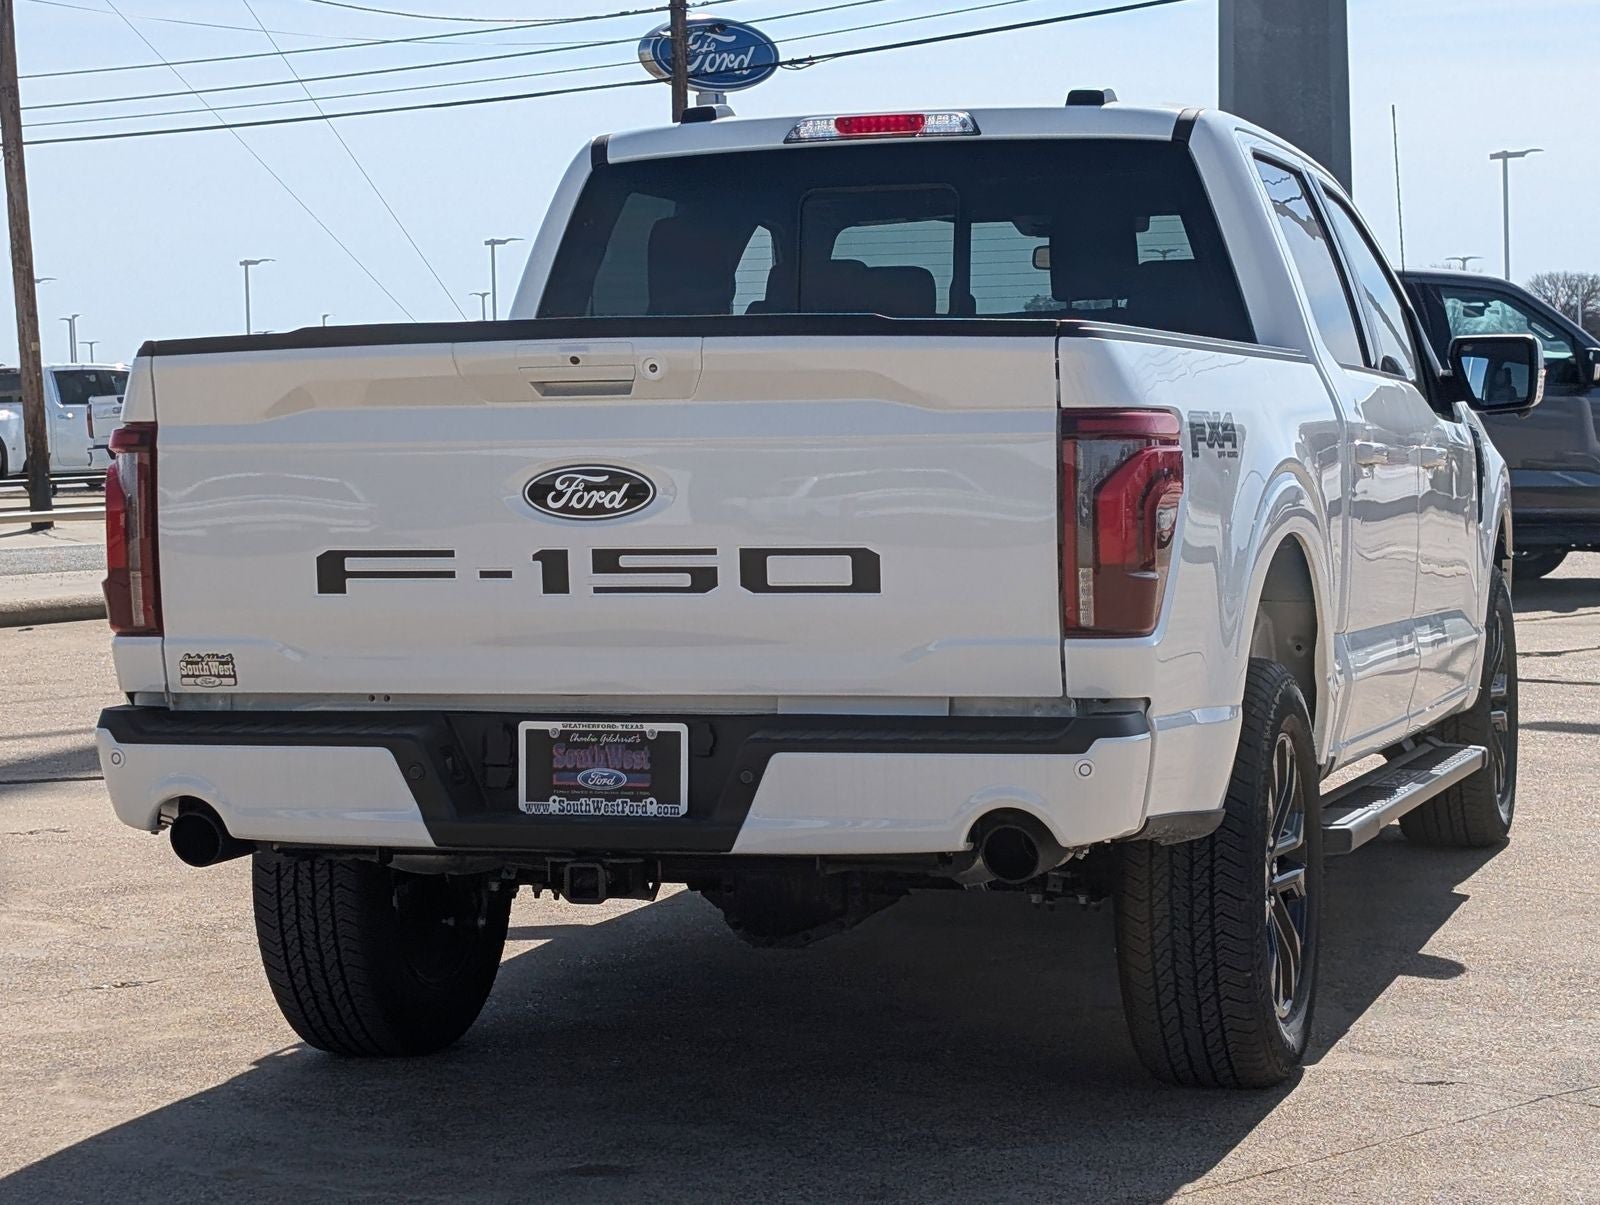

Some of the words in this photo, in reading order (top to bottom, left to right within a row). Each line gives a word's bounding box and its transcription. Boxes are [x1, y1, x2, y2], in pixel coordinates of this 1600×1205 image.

[686, 31, 755, 75] Ford
[1188, 411, 1237, 458] FX4
[547, 473, 628, 509] Ford
[316, 547, 882, 594] F-150
[180, 661, 234, 675] SouthWest
[552, 743, 651, 770] SouthWest
[588, 772, 615, 786] Ford
